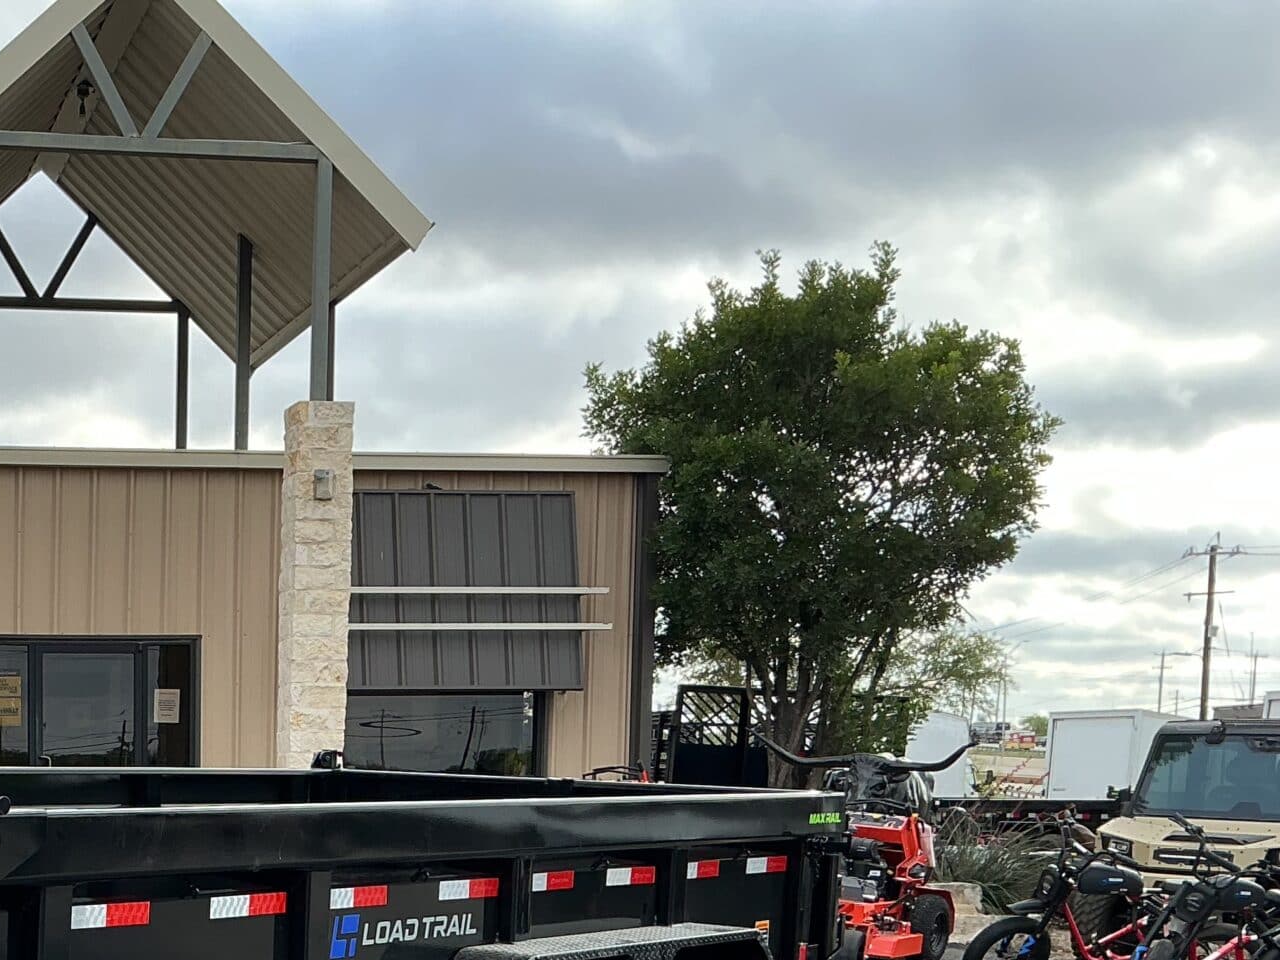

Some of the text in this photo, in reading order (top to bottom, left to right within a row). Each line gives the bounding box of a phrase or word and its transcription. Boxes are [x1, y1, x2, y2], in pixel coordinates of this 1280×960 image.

[809, 812, 841, 824] MAX RAIL
[362, 913, 477, 946] LOAD TRAIL
